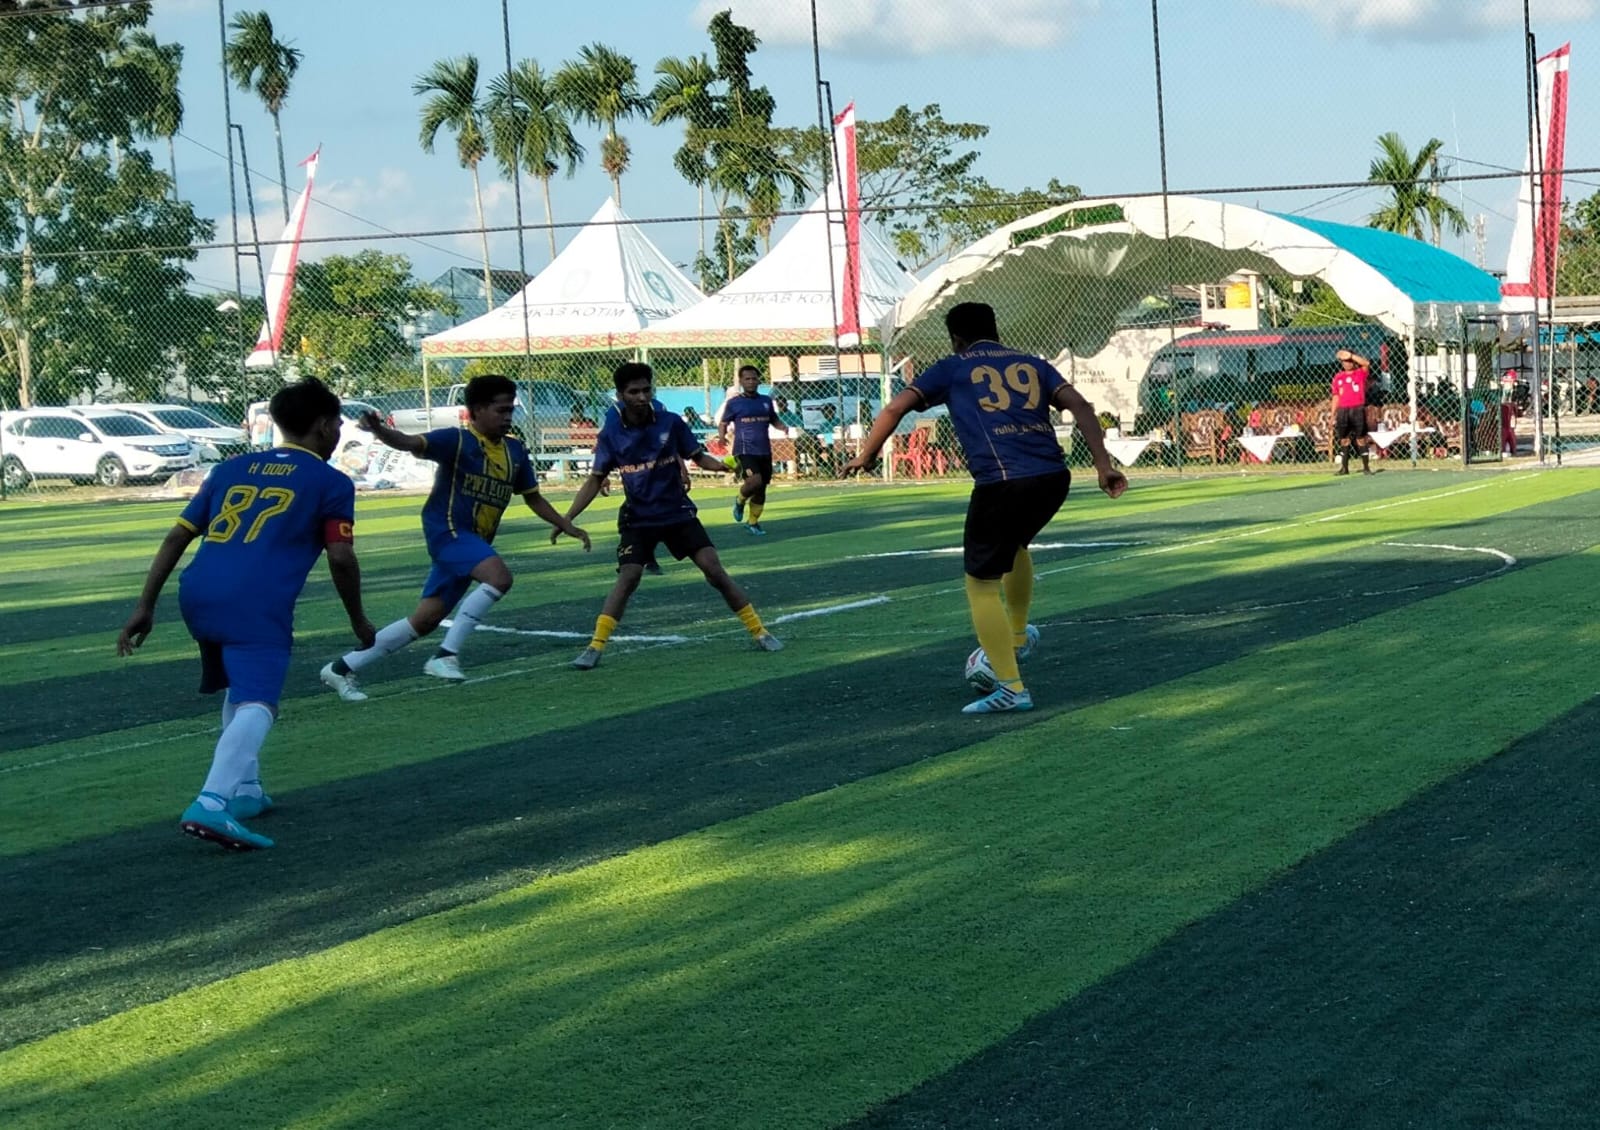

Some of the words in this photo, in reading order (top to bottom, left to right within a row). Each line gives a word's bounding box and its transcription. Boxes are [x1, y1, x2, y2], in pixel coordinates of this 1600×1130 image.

[970, 362, 1041, 412] 39
[248, 462, 259, 475] H
[204, 485, 296, 544] 87
[339, 523, 351, 537] C
